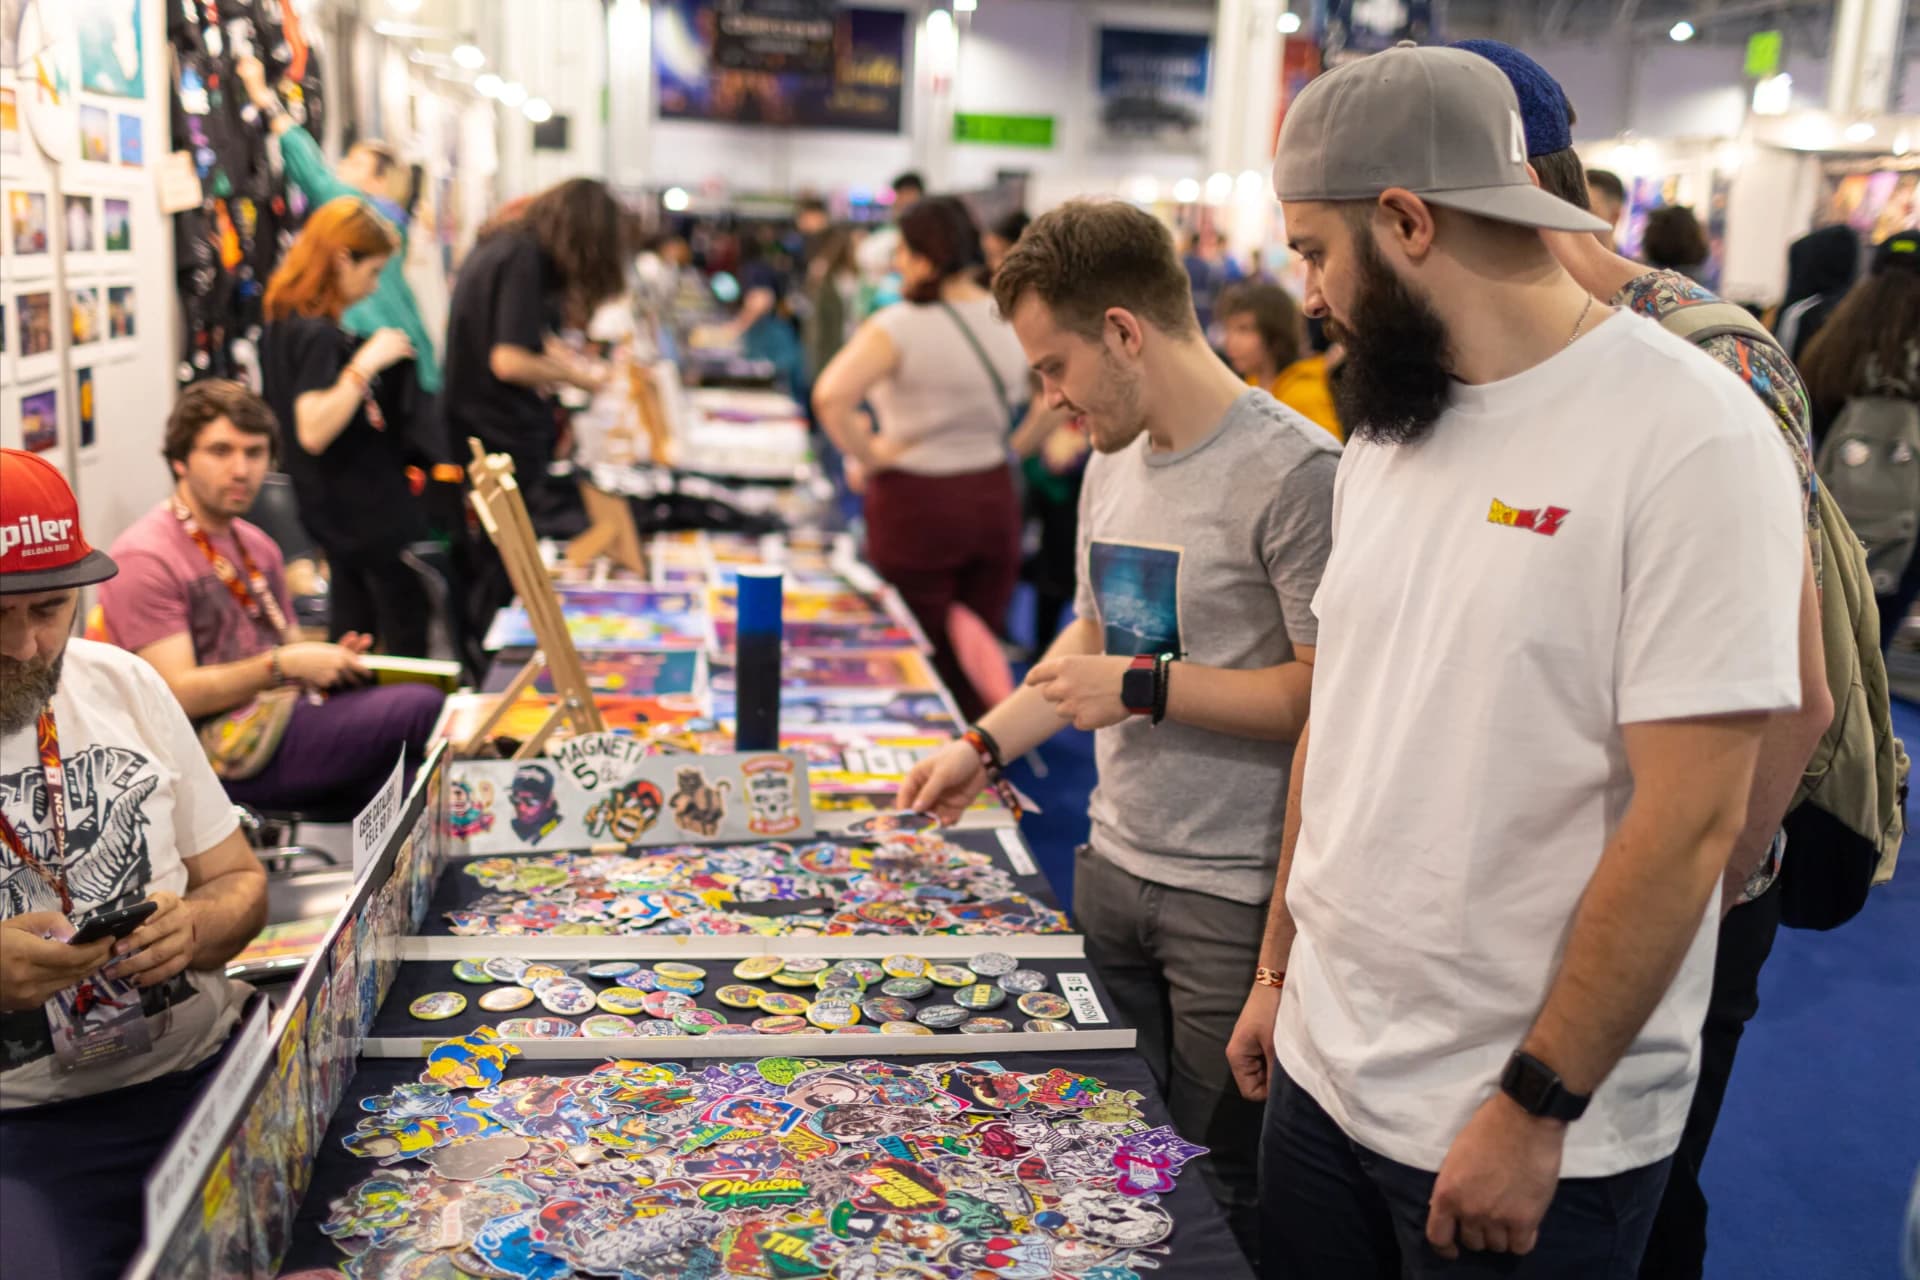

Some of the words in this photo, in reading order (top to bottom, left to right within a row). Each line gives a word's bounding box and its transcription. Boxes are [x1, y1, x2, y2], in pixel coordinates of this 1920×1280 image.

[552, 735, 643, 771] MAGNETI
[572, 761, 599, 791] 5
[53, 793, 65, 828] CON
[870, 1183, 918, 1208] SONS
